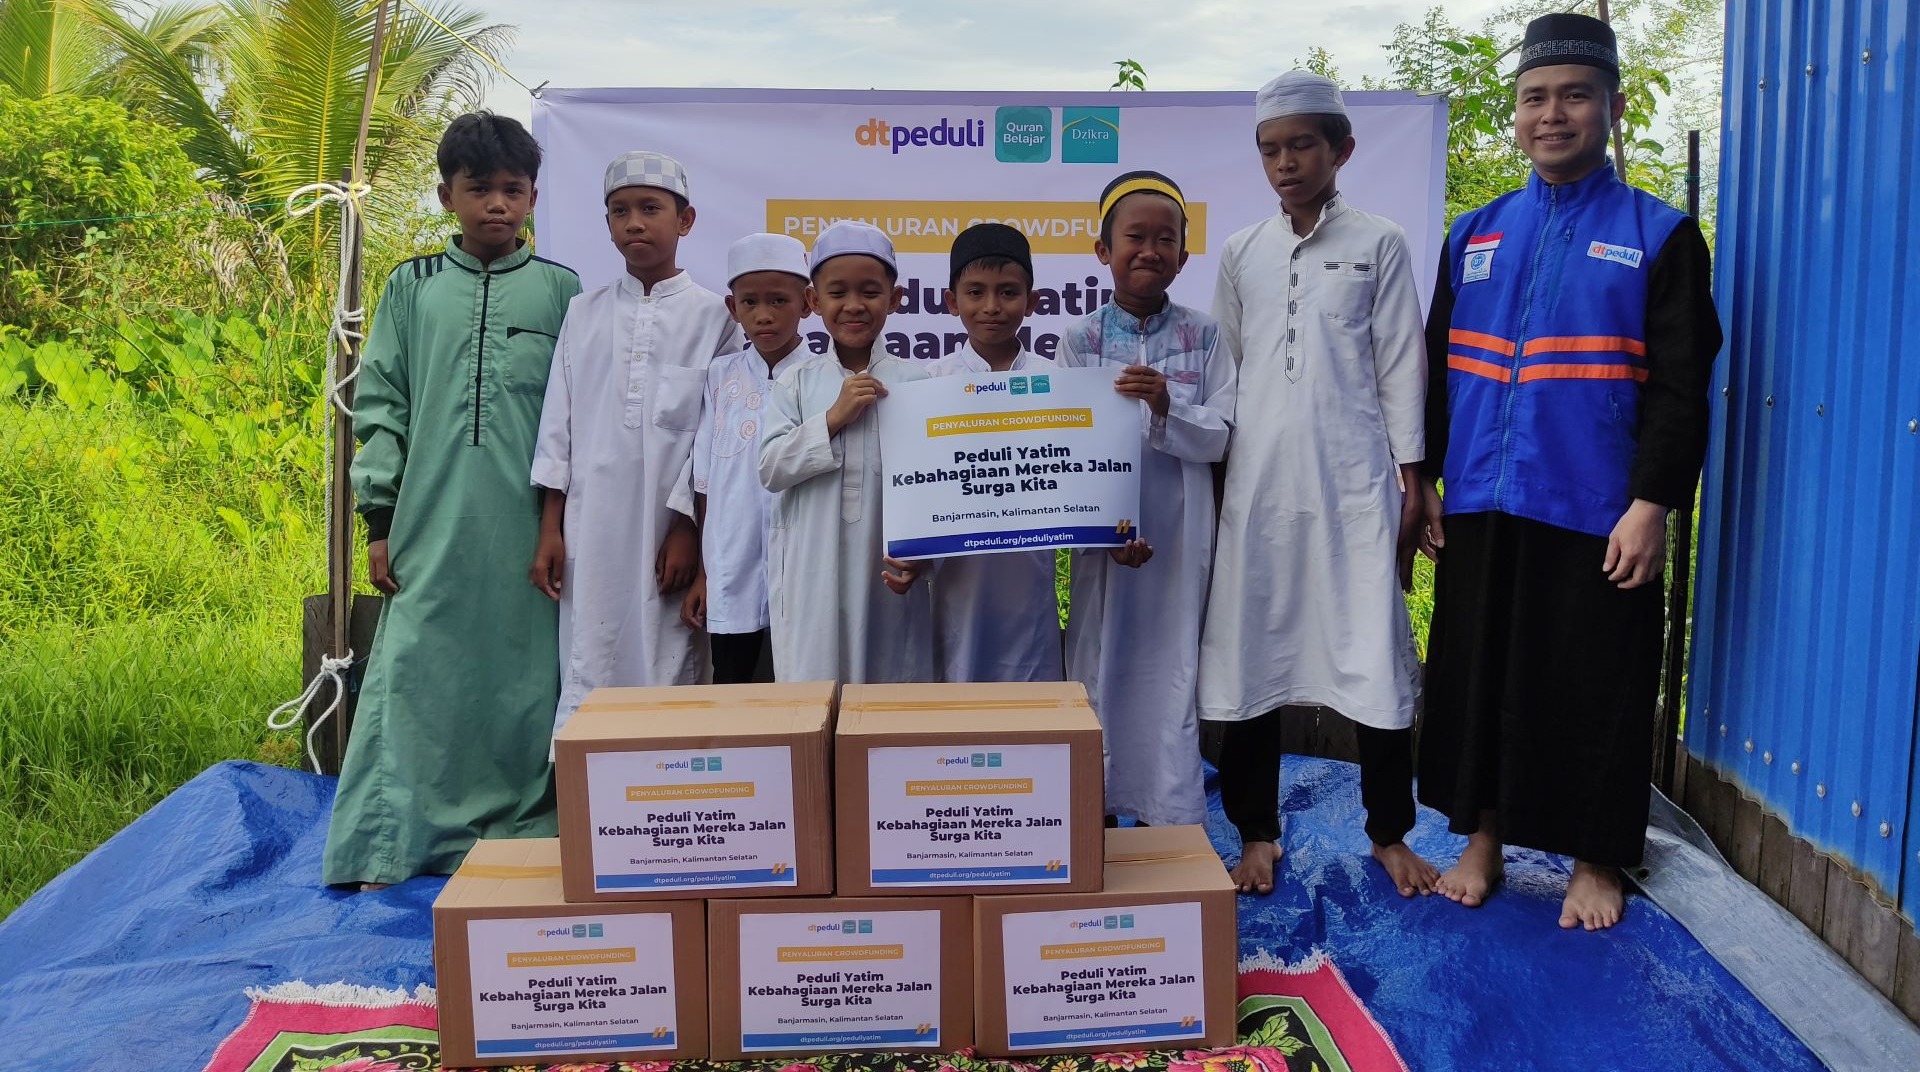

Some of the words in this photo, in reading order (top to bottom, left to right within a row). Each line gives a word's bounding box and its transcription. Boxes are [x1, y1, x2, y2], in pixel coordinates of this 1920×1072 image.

[1006, 122, 1043, 133] Quran
[1072, 128, 1109, 140] Dzikra
[855, 118, 984, 154] dtpeduli
[1003, 133, 1045, 147] Belajar
[784, 216, 959, 236] PENURAN
[1593, 245, 1640, 263] dtpeduli
[964, 383, 1006, 394] dtpeduli
[933, 418, 999, 430] PENYALURAN
[1002, 414, 1086, 426] CROWDFUNDING
[954, 447, 1011, 464] Peduli
[1017, 444, 1070, 460] Yatim
[893, 465, 1009, 487] Kebahagiaan
[1016, 461, 1083, 476] Mereka
[1088, 459, 1132, 473] Jalan
[962, 480, 1015, 497] Surga
[1021, 478, 1057, 492] Kita
[933, 510, 999, 523] Banjarmasin,
[1002, 505, 1060, 517] Kalimantan
[1064, 504, 1100, 512] Selatan
[964, 533, 1073, 547] dtpeduli.org/peduliyatim
[647, 811, 690, 823] Peduli
[695, 810, 735, 821] Yatim
[926, 806, 969, 817] Peduli
[973, 806, 1013, 816] Yatim
[599, 825, 689, 836] Kebahagiaan
[694, 822, 745, 833] Mereka
[749, 821, 785, 831] Jalan
[877, 820, 966, 831] Kebahagiaan
[971, 819, 1022, 828] Mereka
[1026, 817, 1062, 827] Jalan
[653, 835, 693, 848] Surga
[698, 834, 724, 845] Kita
[930, 831, 970, 842] Surga
[975, 830, 1001, 840] Kita
[630, 857, 680, 865] Banjarmasin,
[682, 855, 726, 863] Kalimantan
[797, 972, 840, 983] Peduli
[844, 971, 883, 981] Yatim
[1061, 968, 1104, 980] Peduli
[1108, 966, 1147, 976] Yatim
[529, 977, 572, 988] Peduli
[576, 976, 617, 986] Yatim
[1013, 982, 1101, 995] Kebahagiaan
[1106, 978, 1155, 989] Mereka
[1160, 975, 1195, 985] Jalan
[480, 990, 570, 1002] Kebahagiaan
[575, 988, 626, 999] Mereka
[630, 985, 666, 995] Jalan
[749, 986, 837, 997] Kebahagiaan
[842, 984, 892, 994] Mereka
[896, 982, 932, 992] Jalan
[802, 997, 840, 1008] Surga
[845, 995, 872, 1005] Kita
[1066, 992, 1104, 1004] Surga
[1109, 990, 1136, 1000] Kita
[534, 1001, 574, 1012] Surga
[579, 999, 606, 1010] Kita
[1044, 1014, 1092, 1022] Banjarmasin,
[1095, 1010, 1137, 1018] Kalimantan
[512, 1022, 561, 1030] Banjarmasin,
